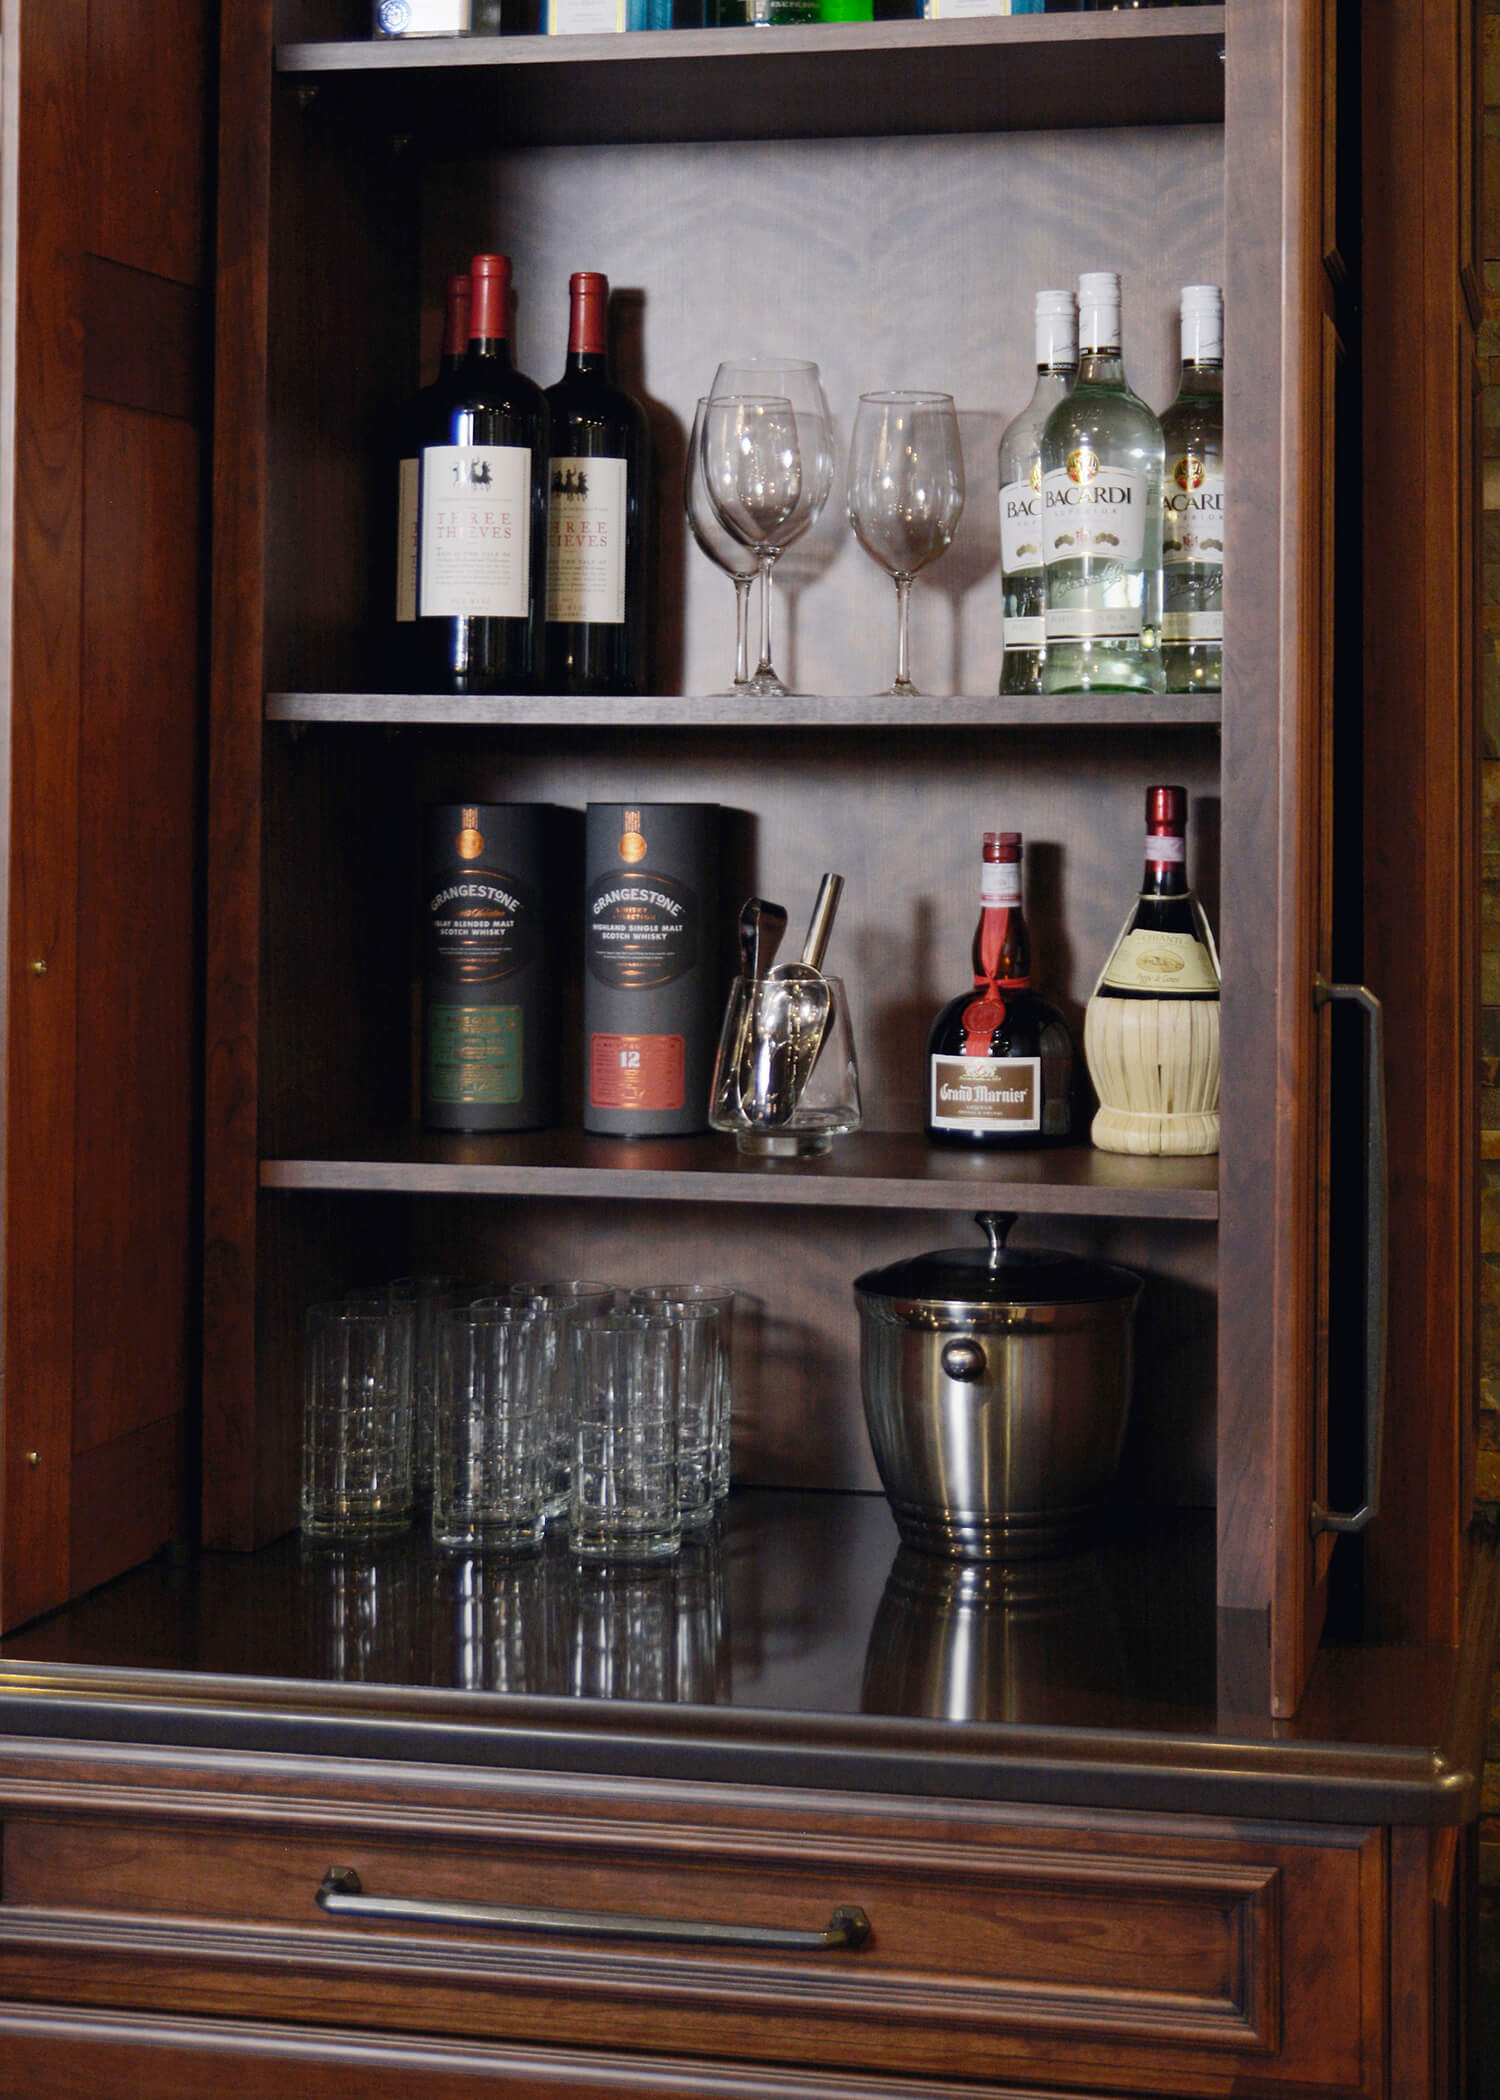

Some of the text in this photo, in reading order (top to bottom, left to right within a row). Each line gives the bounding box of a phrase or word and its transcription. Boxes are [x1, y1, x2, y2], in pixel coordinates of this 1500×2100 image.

[1045, 487, 1132, 508] BACARDI
[437, 526, 512, 539] THEVES
[431, 884, 521, 912] GRANGESTONE
[592, 888, 682, 917] GRANGESTONE
[439, 928, 506, 936] SCOTCH WHISKY
[602, 932, 668, 940] SCOTCH WHISKY
[629, 924, 659, 932] SINGLE
[661, 924, 683, 932] MALT
[620, 1051, 641, 1068] 12
[940, 1083, 1026, 1103] Grand Marnier
